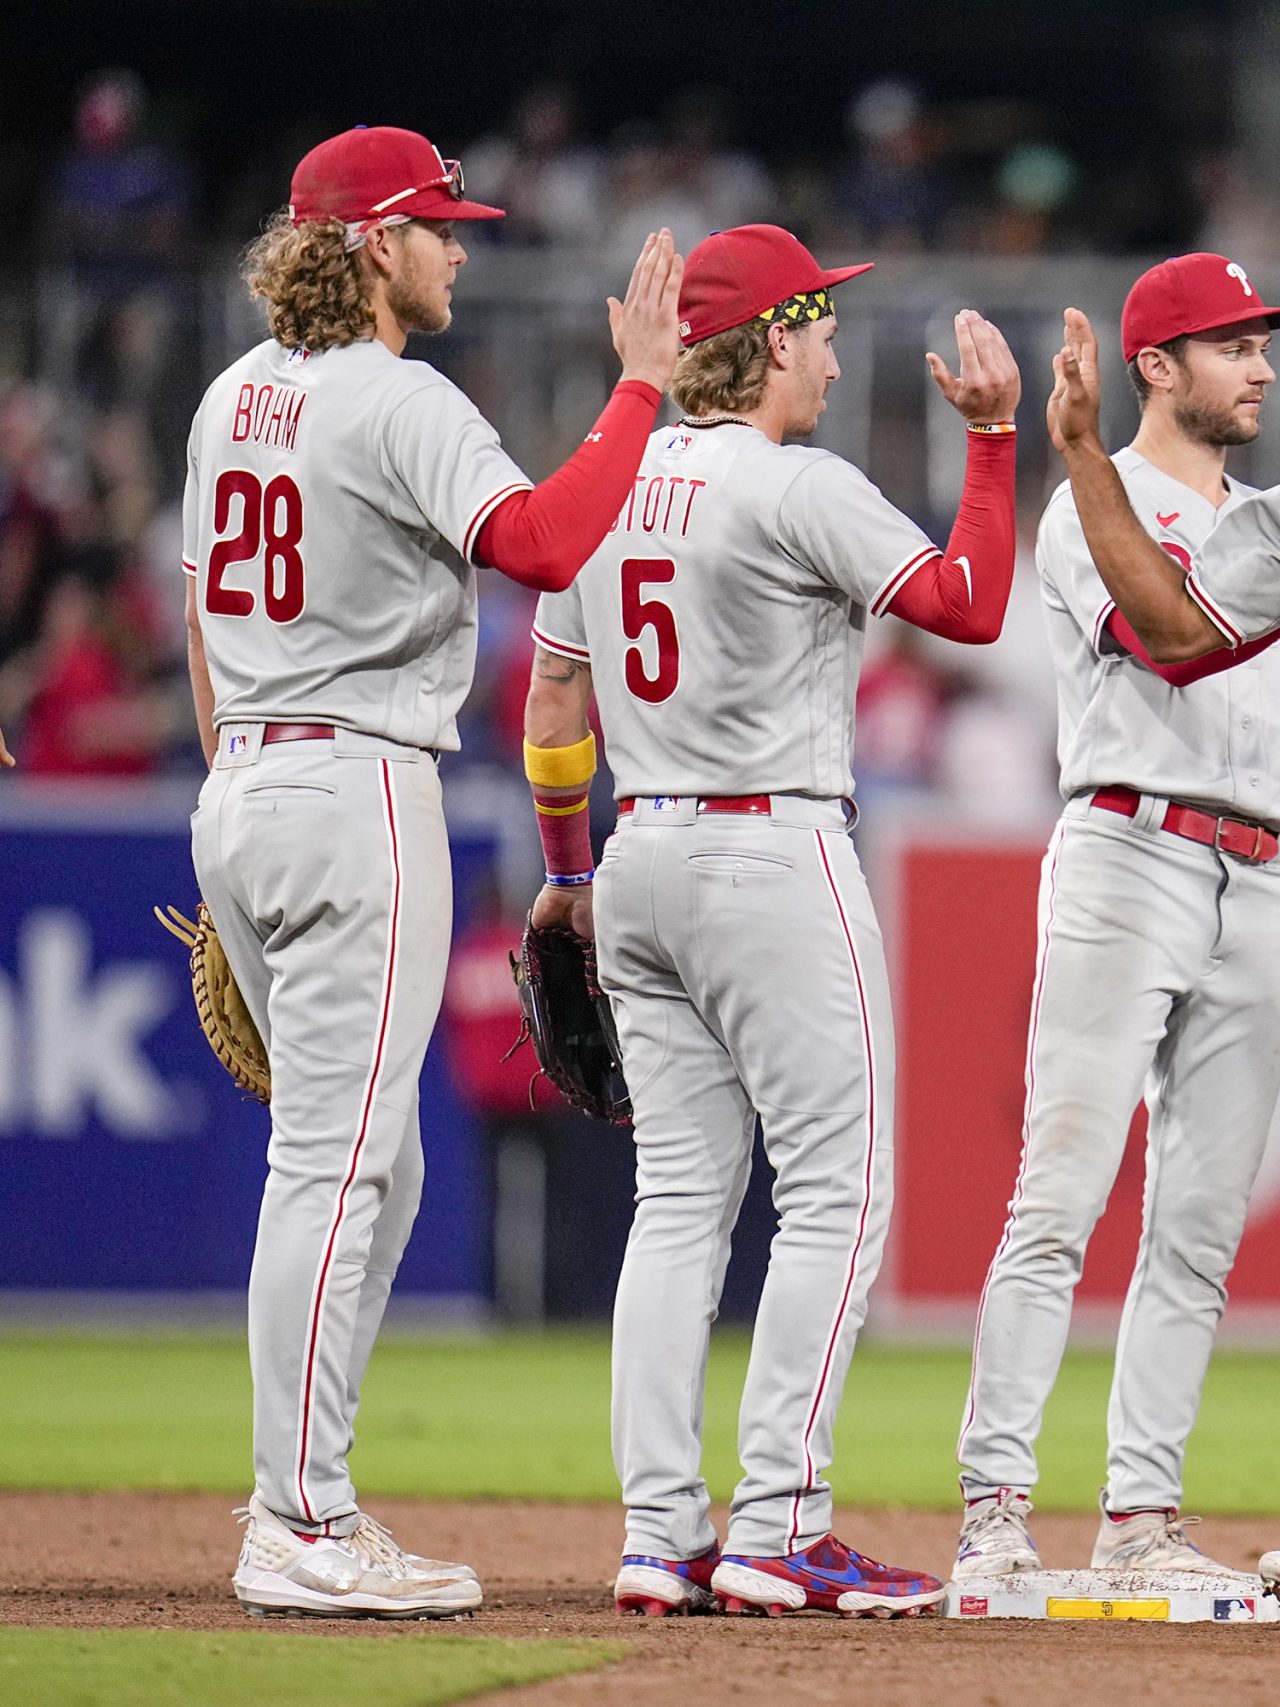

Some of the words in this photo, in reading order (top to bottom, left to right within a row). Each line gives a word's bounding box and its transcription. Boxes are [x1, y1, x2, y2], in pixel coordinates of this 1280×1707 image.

[232, 382, 307, 452] BOHM
[206, 469, 305, 626] 28
[607, 475, 707, 538] TOTT
[620, 556, 680, 706] 5
